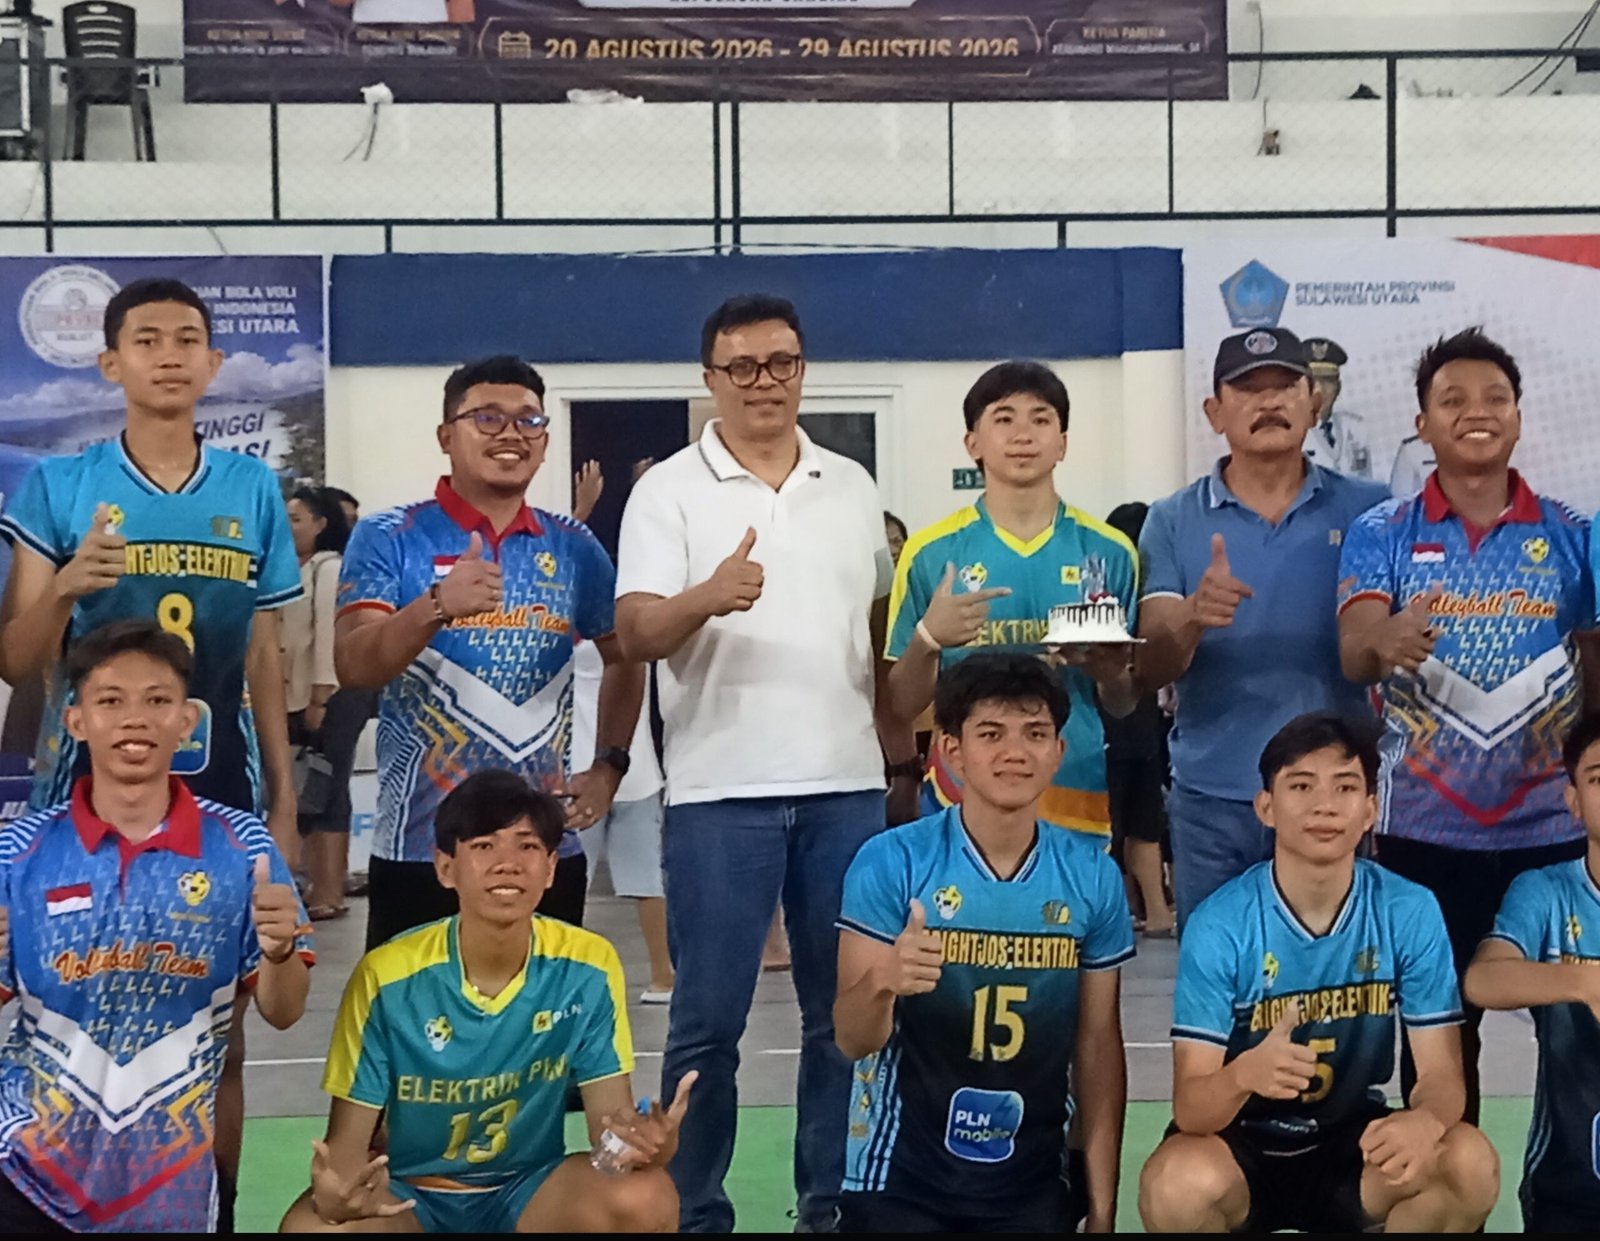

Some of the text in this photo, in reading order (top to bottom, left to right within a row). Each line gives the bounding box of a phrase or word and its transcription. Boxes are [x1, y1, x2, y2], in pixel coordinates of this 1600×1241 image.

[585, 38, 705, 59] AGUSTUS
[1295, 280, 1456, 293] PEMERINTAH PROVINSI
[213, 302, 296, 315] INDONESIA
[1295, 292, 1420, 306] SULAWESI UTARA
[239, 319, 300, 335] UTARA
[1505, 588, 1557, 619] Team
[152, 940, 209, 979] Team
[968, 985, 1029, 1063] 15
[954, 1110, 991, 1127] PLN
[440, 1099, 518, 1165] 13
